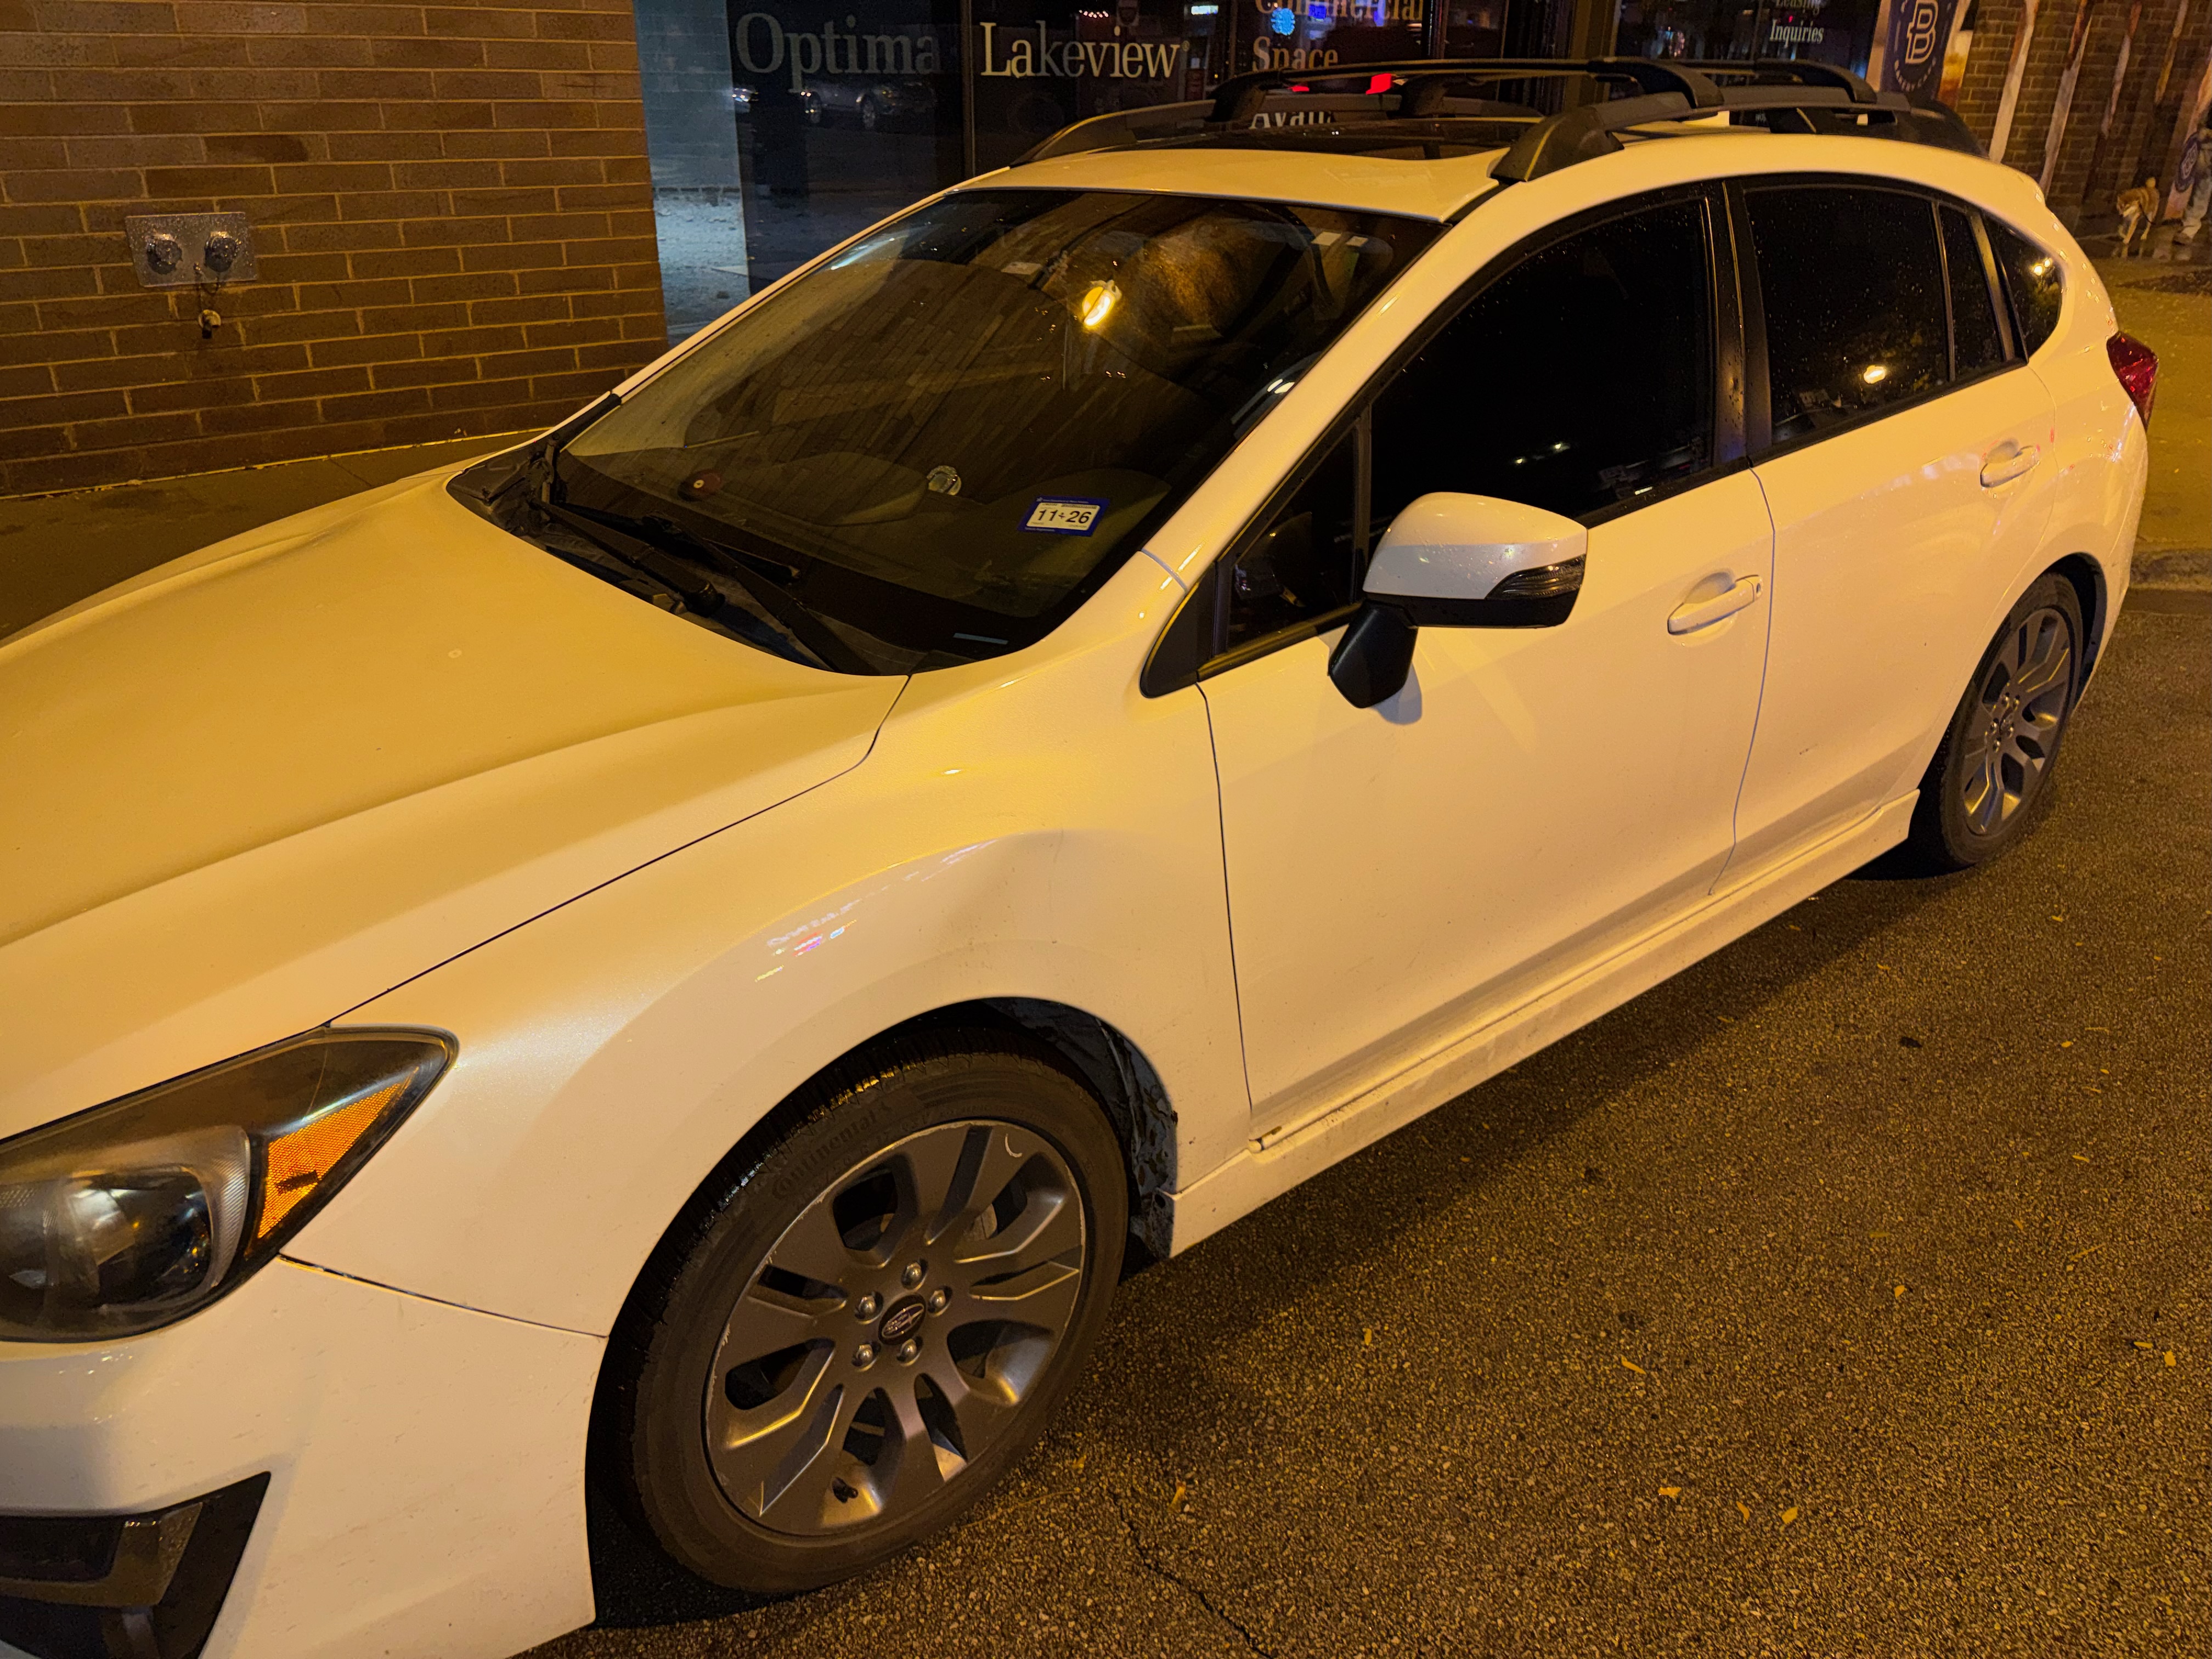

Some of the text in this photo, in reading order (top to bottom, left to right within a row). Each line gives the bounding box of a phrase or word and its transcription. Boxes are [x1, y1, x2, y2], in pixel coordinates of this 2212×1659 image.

[1769, 19, 1824, 48] Inquiries
[736, 13, 1180, 93] Optima Lakeview
[1252, 36, 1339, 72] Space
